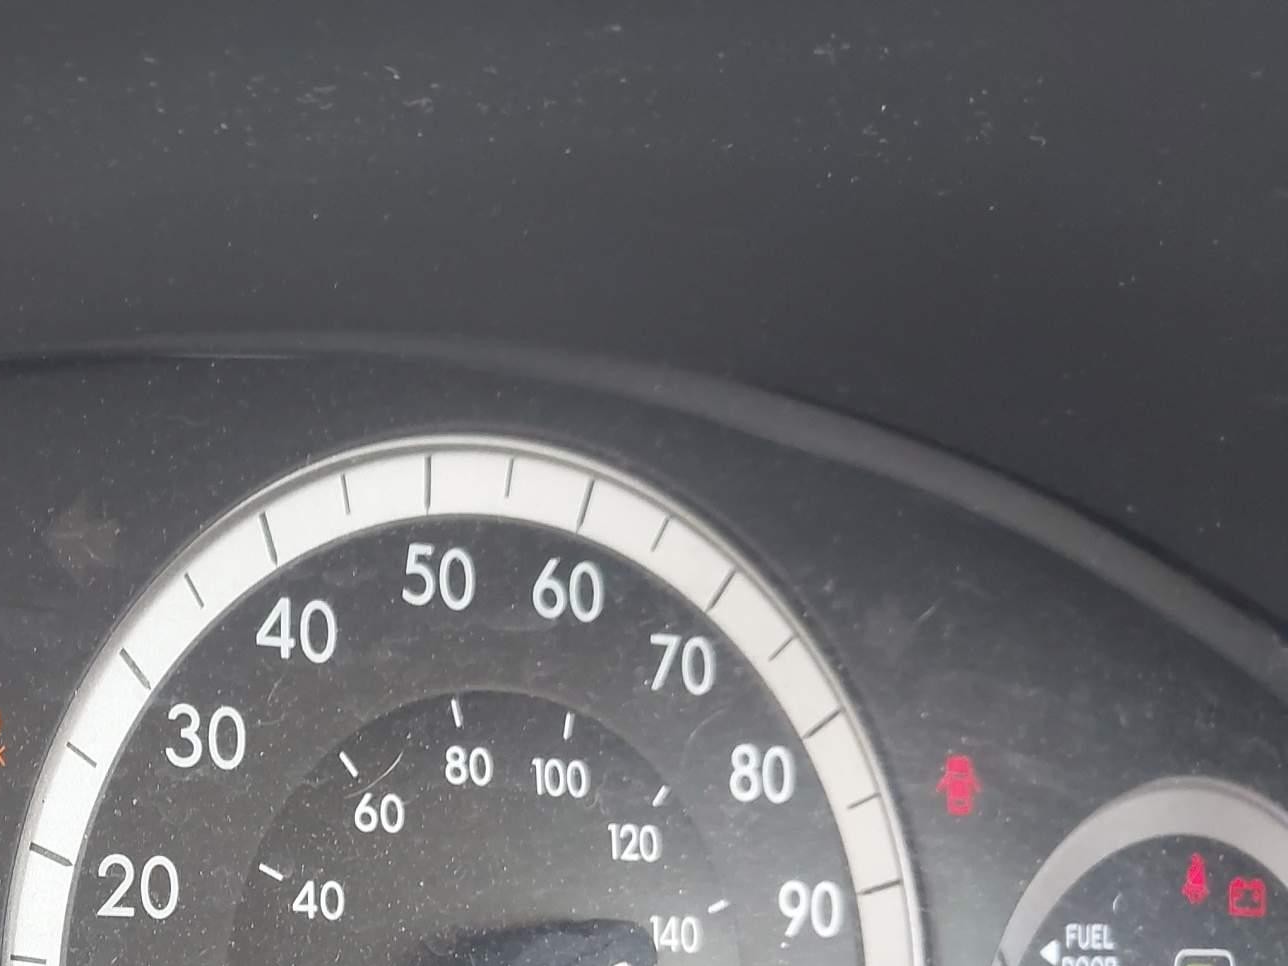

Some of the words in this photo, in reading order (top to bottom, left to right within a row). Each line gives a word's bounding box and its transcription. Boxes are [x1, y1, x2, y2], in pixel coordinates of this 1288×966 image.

[402, 543, 475, 611] 50
[533, 557, 604, 623] 60
[256, 597, 337, 663] 40
[650, 633, 715, 696] 70
[165, 703, 246, 770] 30
[444, 745, 494, 787] 80
[531, 758, 590, 799] 100
[729, 743, 796, 804] 80
[355, 792, 405, 833] 60
[608, 823, 662, 863] 120
[97, 853, 180, 920] 20
[293, 880, 344, 920] 40
[778, 881, 843, 938] 90
[650, 916, 701, 953] 140
[1065, 924, 1115, 949] FUEL
